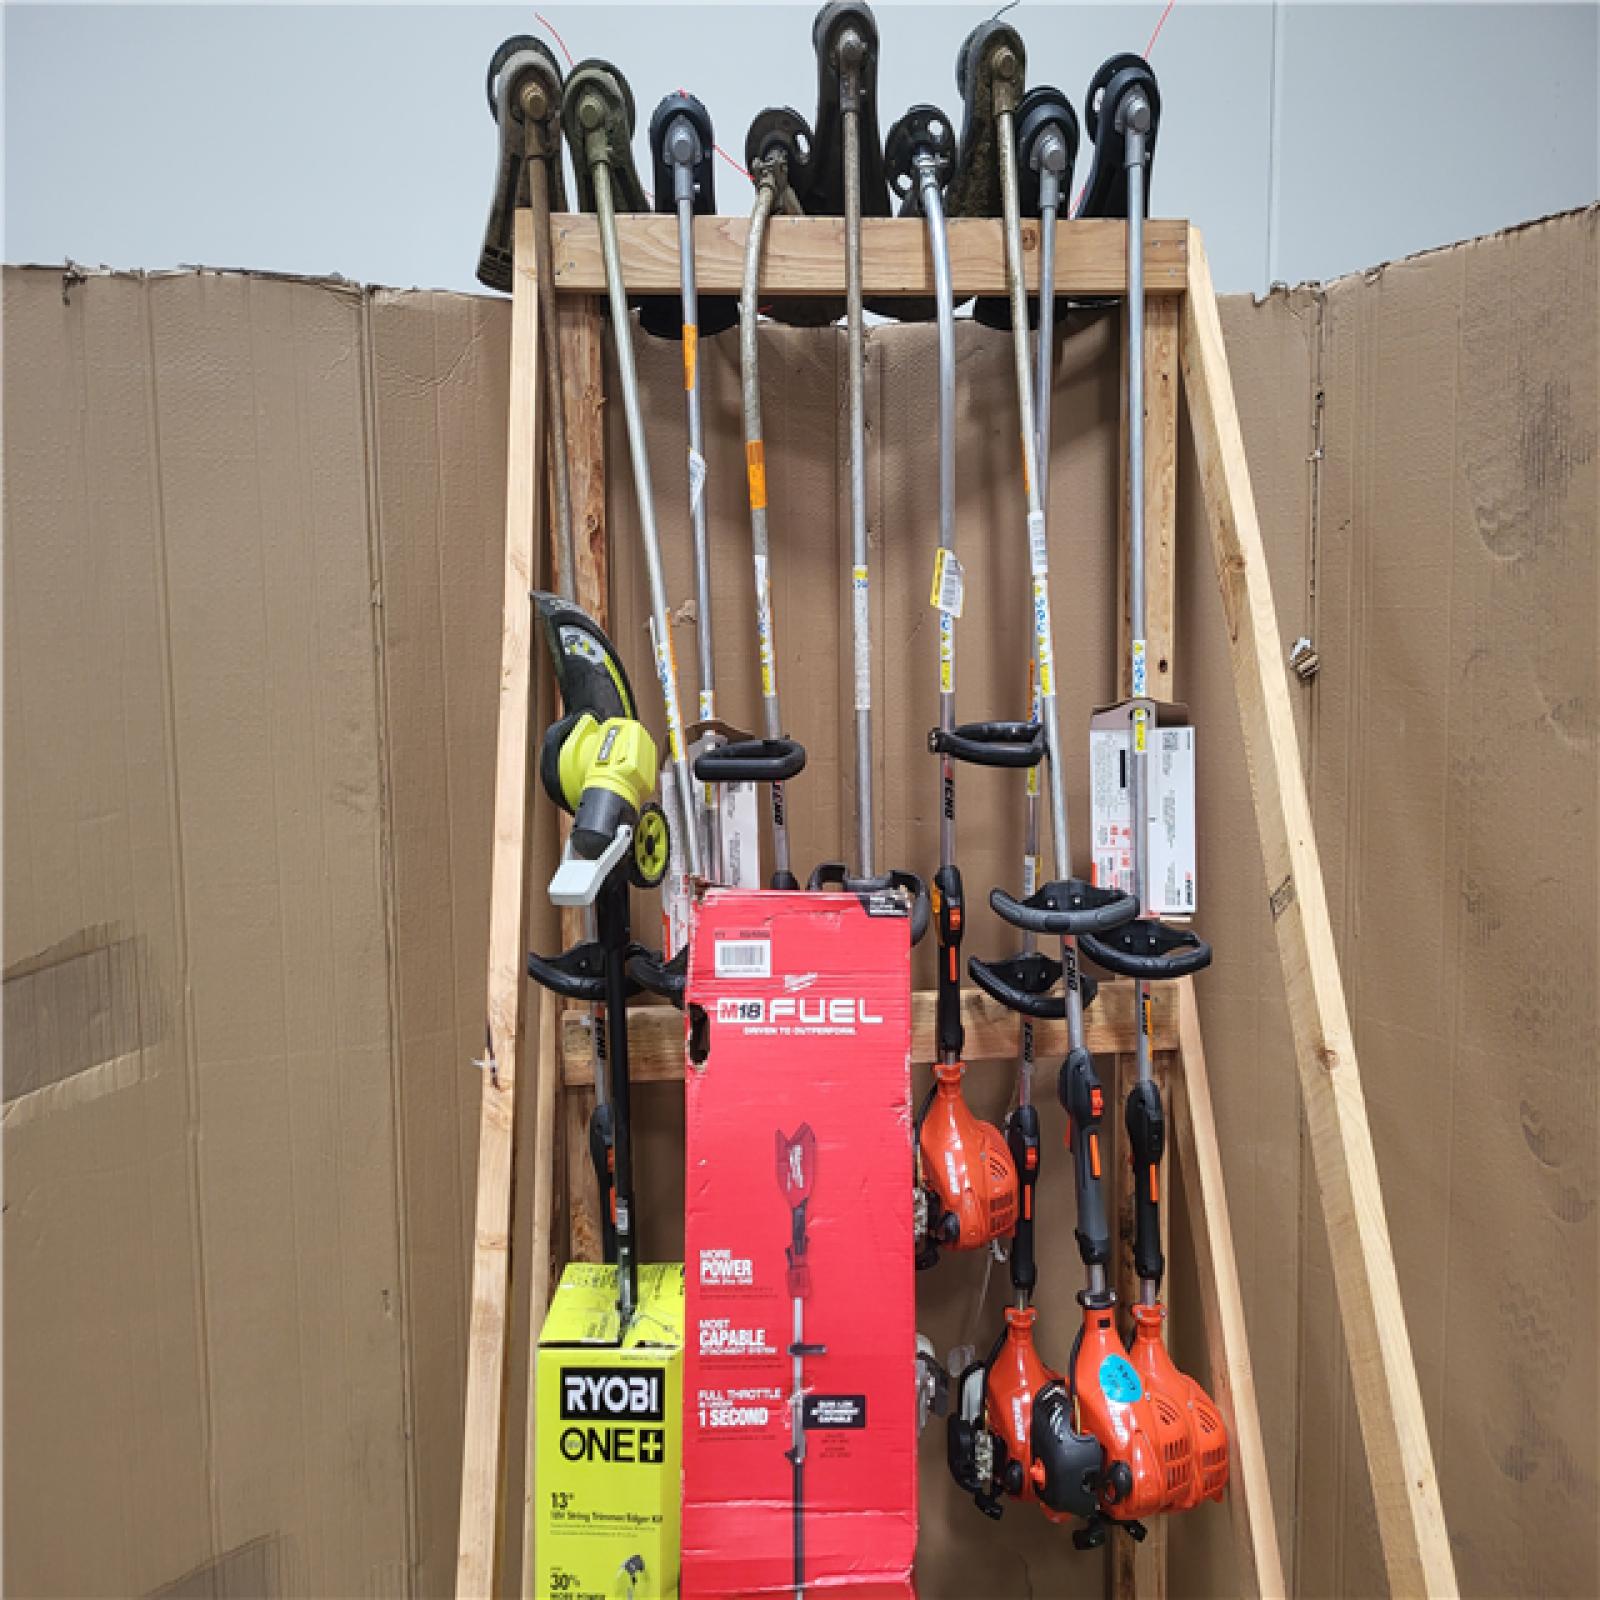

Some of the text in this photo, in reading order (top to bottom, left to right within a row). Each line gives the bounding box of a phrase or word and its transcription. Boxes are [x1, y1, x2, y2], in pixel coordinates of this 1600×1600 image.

[944, 777, 955, 820] ECHO
[1065, 945, 1078, 991] ECHO
[720, 998, 884, 1024] M18 FUEL
[701, 1259, 752, 1276] POWER
[700, 1329, 765, 1347] CAPABLE
[565, 1375, 659, 1413] RYOBI
[698, 1407, 769, 1428] 1 SECOND
